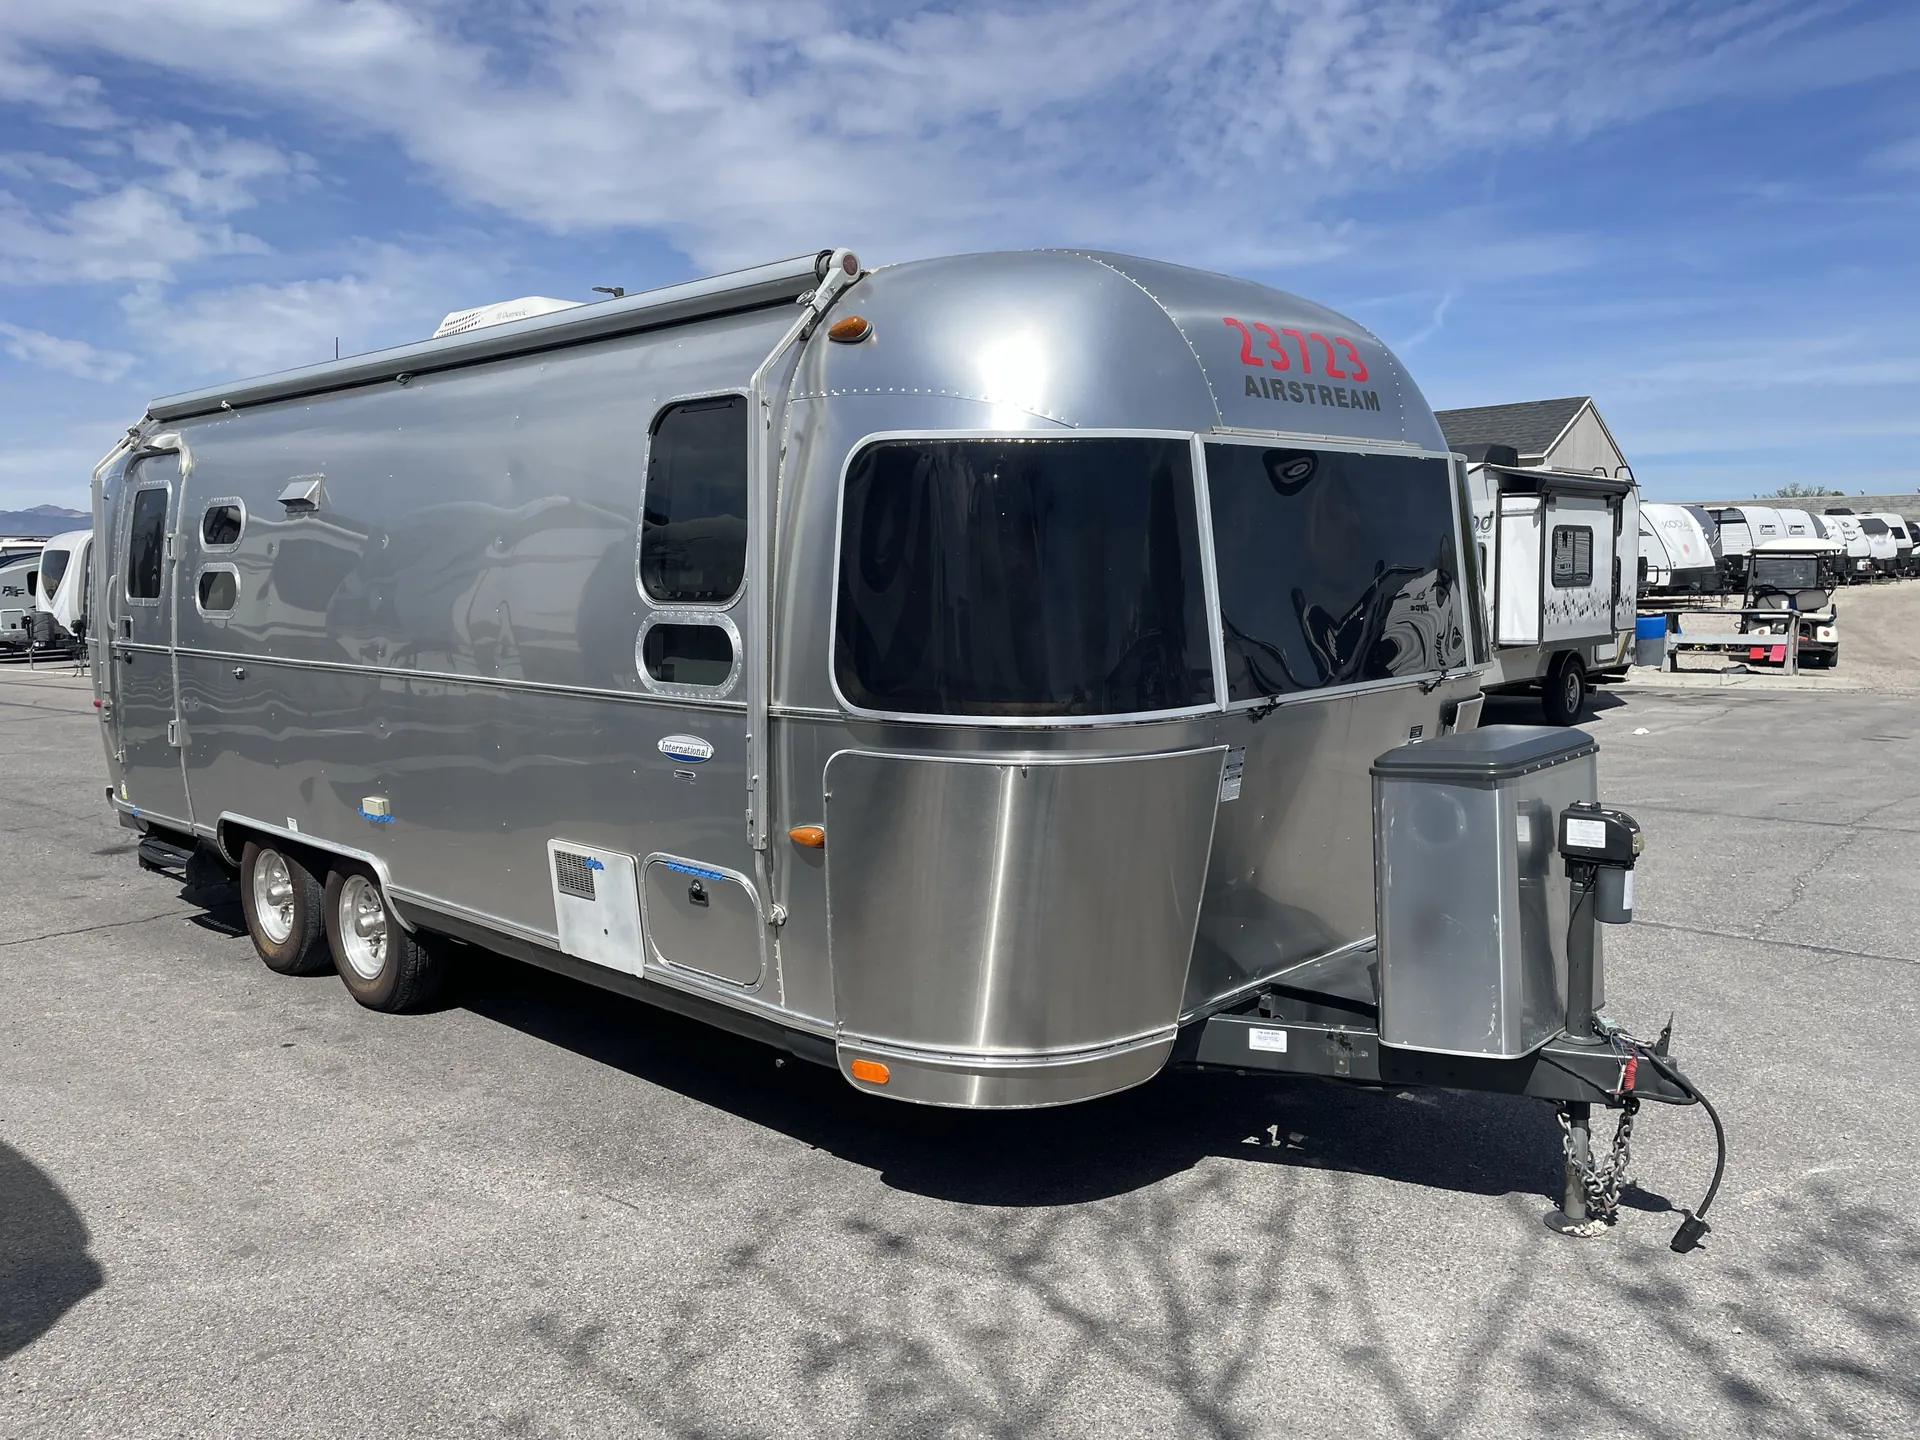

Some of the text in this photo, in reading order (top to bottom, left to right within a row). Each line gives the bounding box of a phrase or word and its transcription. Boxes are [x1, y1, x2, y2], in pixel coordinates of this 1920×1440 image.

[1222, 317, 1369, 382] 23723
[1245, 375, 1381, 411] AIRSTREAM
[661, 741, 709, 756] International
